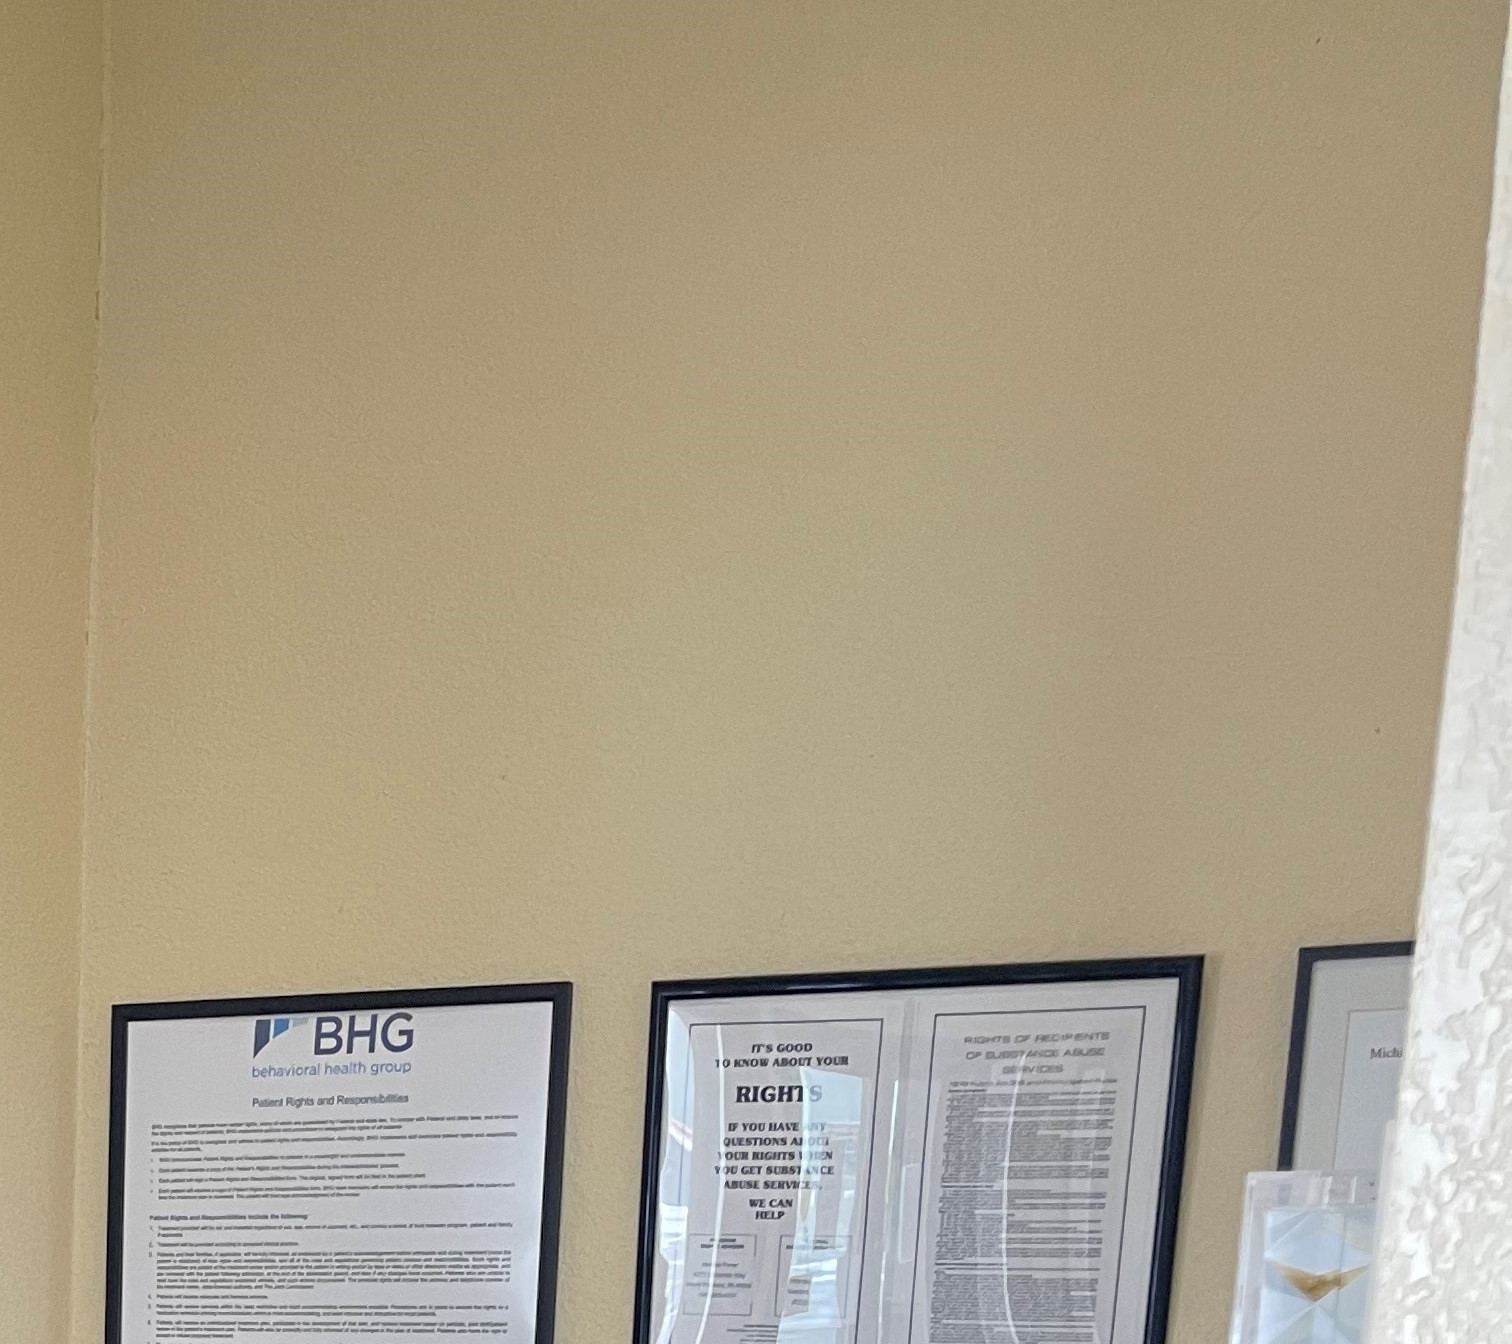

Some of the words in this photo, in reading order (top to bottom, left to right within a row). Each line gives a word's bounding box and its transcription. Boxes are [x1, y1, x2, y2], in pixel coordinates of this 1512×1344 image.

[314, 1012, 414, 1055] BHG
[751, 1043, 773, 1054] IT'S
[776, 1043, 813, 1053] GOOD
[1063, 1047, 1105, 1057] ABUSE
[734, 1058, 769, 1068] KNOW
[772, 1057, 812, 1067] ABOUT
[816, 1056, 849, 1066] YOUR
[252, 1063, 320, 1078] behavioral
[324, 1062, 366, 1075] health
[370, 1062, 412, 1076] group
[735, 1085, 823, 1103] RIGHTS
[252, 1097, 284, 1107] Patient
[285, 1097, 314, 1109] Rights
[316, 1095, 335, 1106] and
[337, 1093, 409, 1106] Responsibilities
[728, 1122, 739, 1132] IF
[742, 1122, 766, 1132] YOU
[768, 1122, 800, 1132] HAVE
[723, 1137, 787, 1147] QUESTIONS
[752, 1151, 795, 1161] RIGHTS
[741, 1165, 762, 1175] GET
[724, 1180, 761, 1190] ABUSE
[749, 1198, 766, 1208] WE
[769, 1198, 793, 1208] CAN
[755, 1210, 785, 1220] HELP
